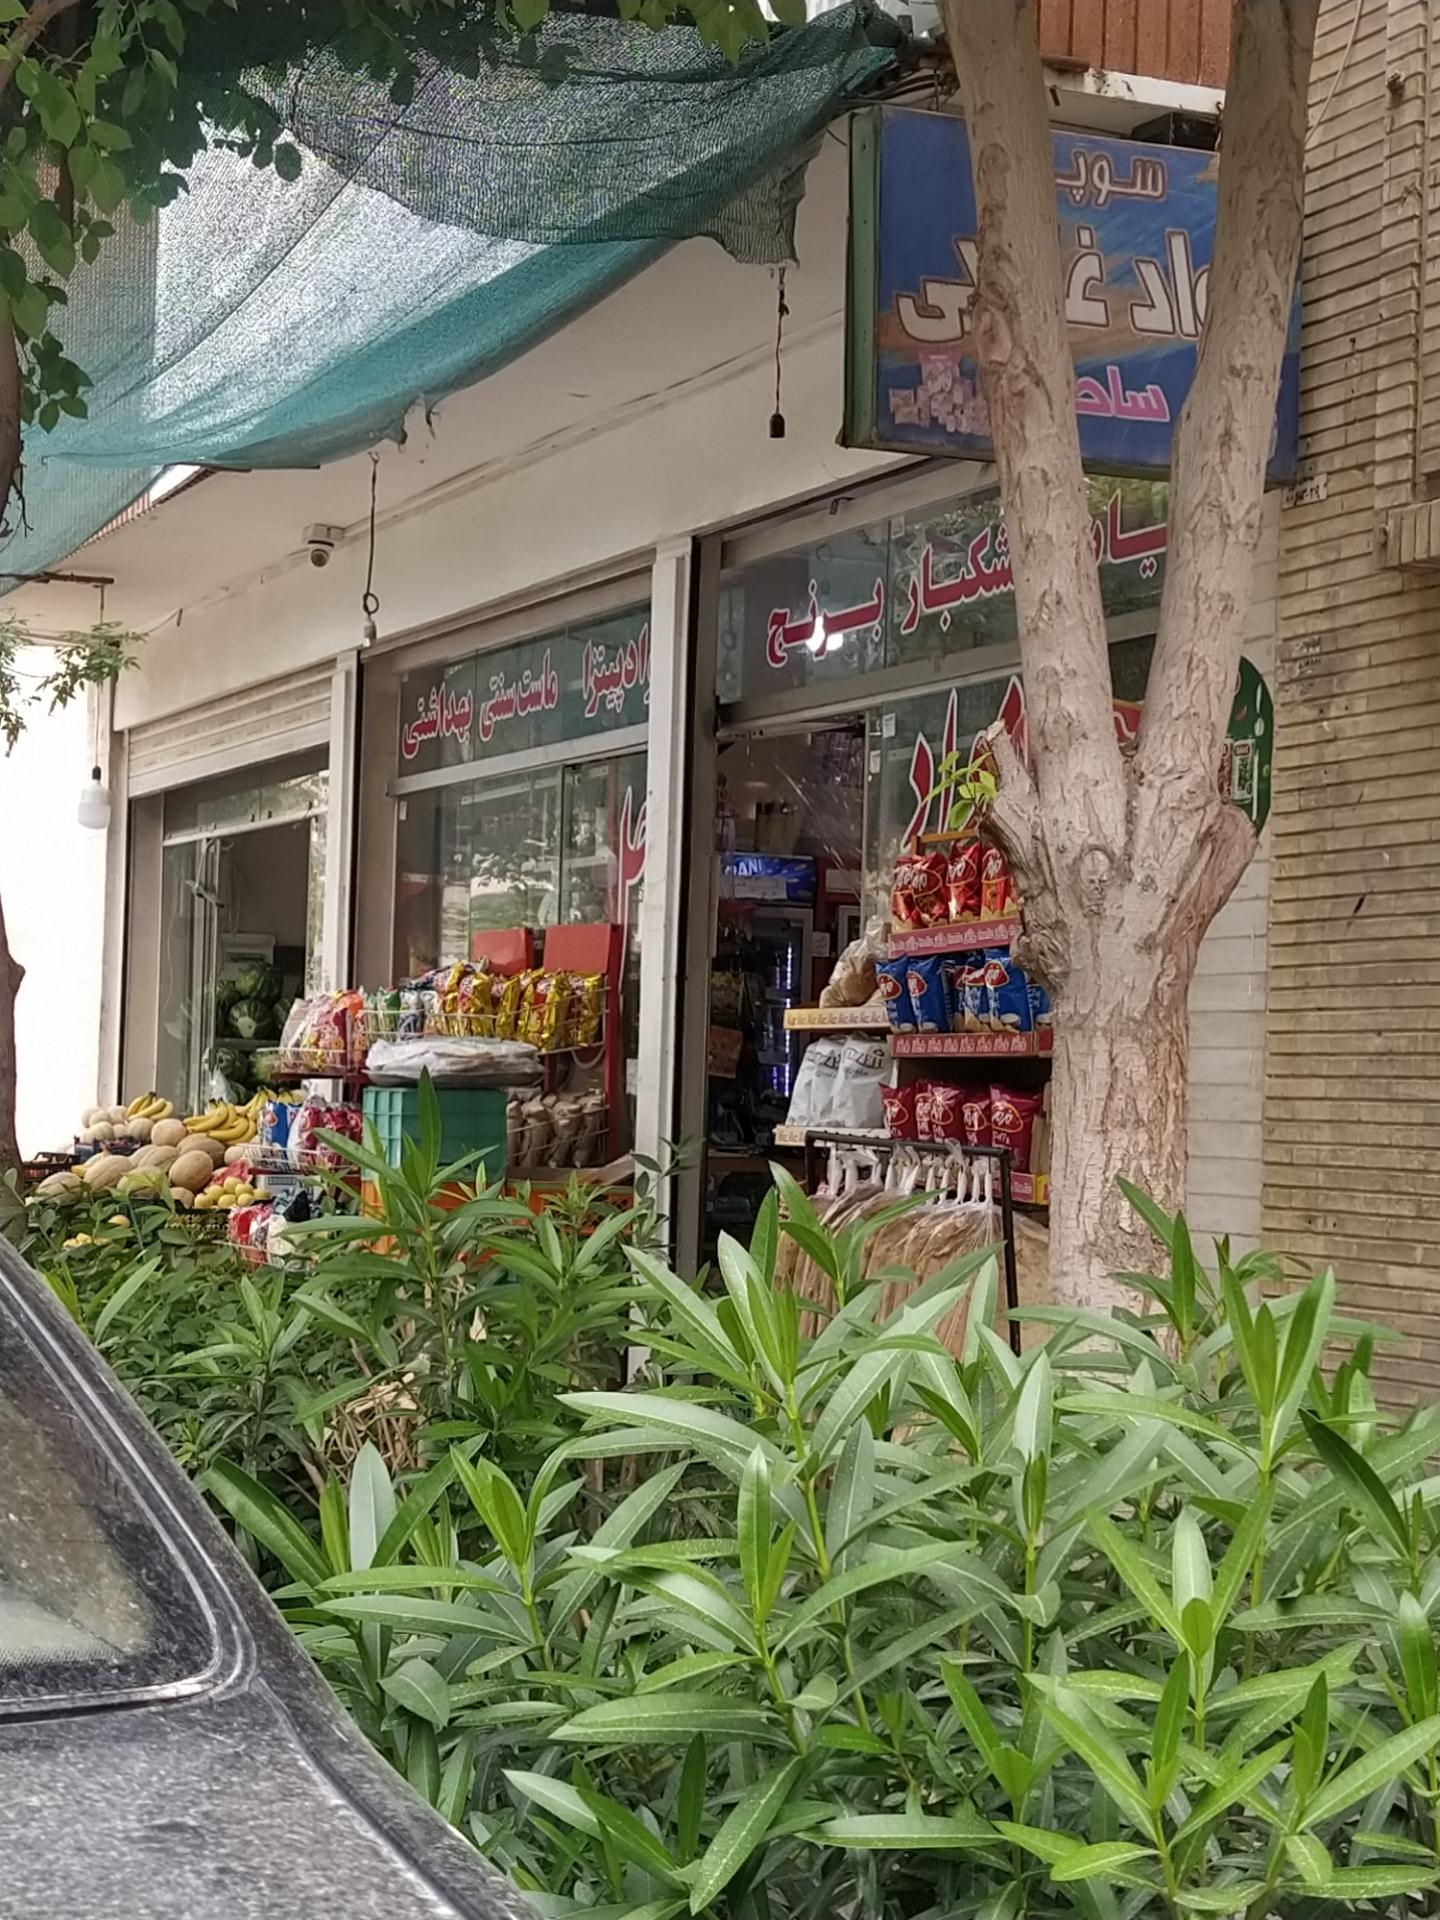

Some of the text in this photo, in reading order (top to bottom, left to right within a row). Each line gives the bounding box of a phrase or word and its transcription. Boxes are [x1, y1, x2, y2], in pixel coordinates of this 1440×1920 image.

[1056, 151, 1167, 208] سوپ
[1076, 365, 1170, 422] ساح
[901, 522, 1014, 634] شکبار
[765, 580, 884, 668] برنج
[479, 672, 517, 742] سنتی
[517, 648, 558, 716] ماست
[402, 682, 473, 759] بهداشتی
